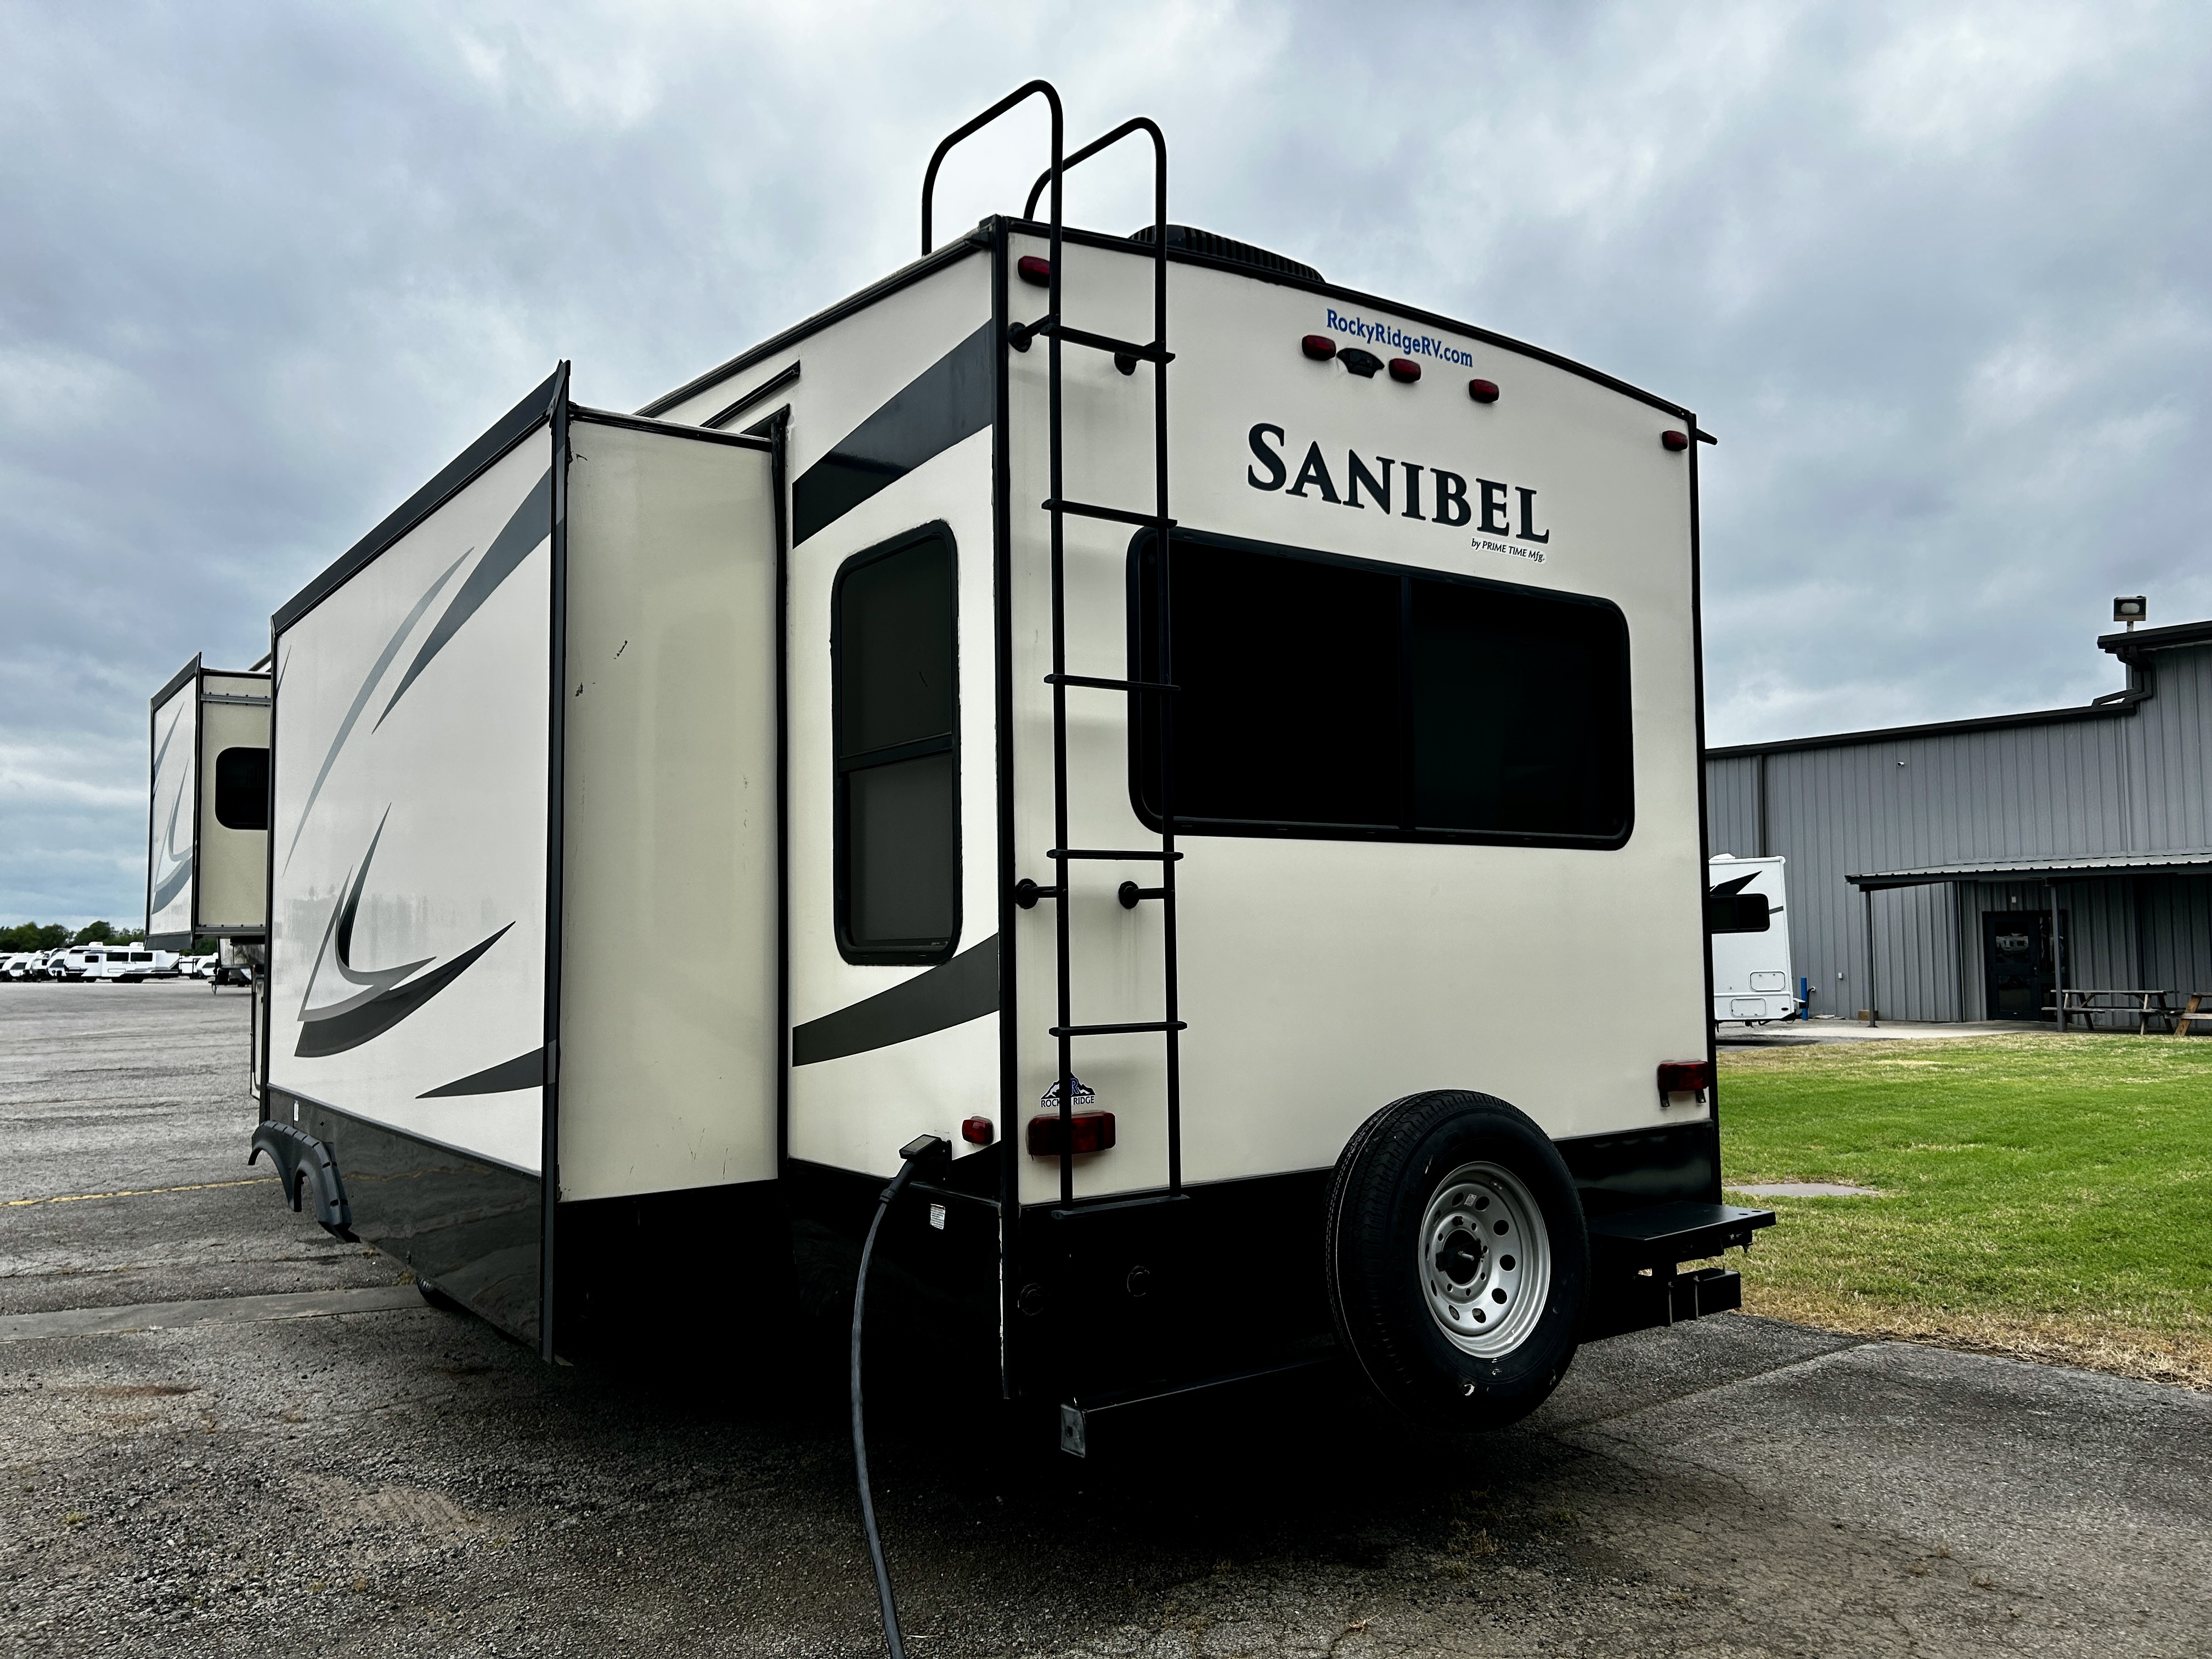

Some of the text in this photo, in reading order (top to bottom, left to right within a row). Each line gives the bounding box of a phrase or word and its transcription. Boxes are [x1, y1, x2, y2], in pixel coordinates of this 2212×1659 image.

[1327, 308, 1472, 368] RockyRidgeRV.com
[1248, 423, 1549, 544] SANIBEL
[1471, 538, 1481, 550] by
[1482, 541, 1506, 552] PRIME
[1509, 546, 1527, 557] TIME
[1041, 1096, 1094, 1108] ROCK RIDGE
